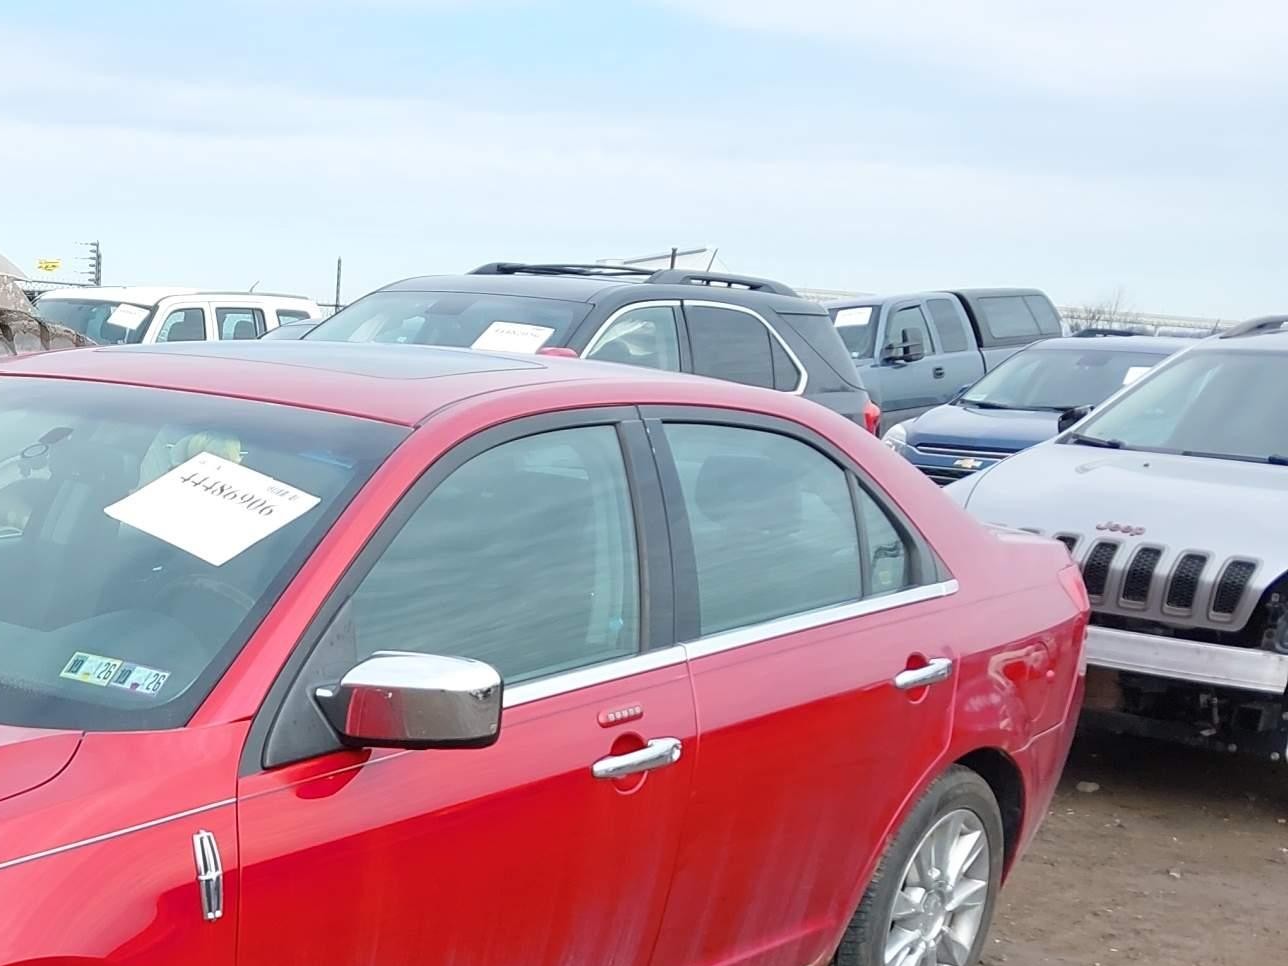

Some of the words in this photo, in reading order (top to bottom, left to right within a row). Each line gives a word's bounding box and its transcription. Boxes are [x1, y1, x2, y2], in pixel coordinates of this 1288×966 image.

[180, 472, 275, 516] 44486906
[1095, 521, 1145, 537] Jeep
[96, 662, 117, 681] 26
[145, 672, 166, 692] 26
